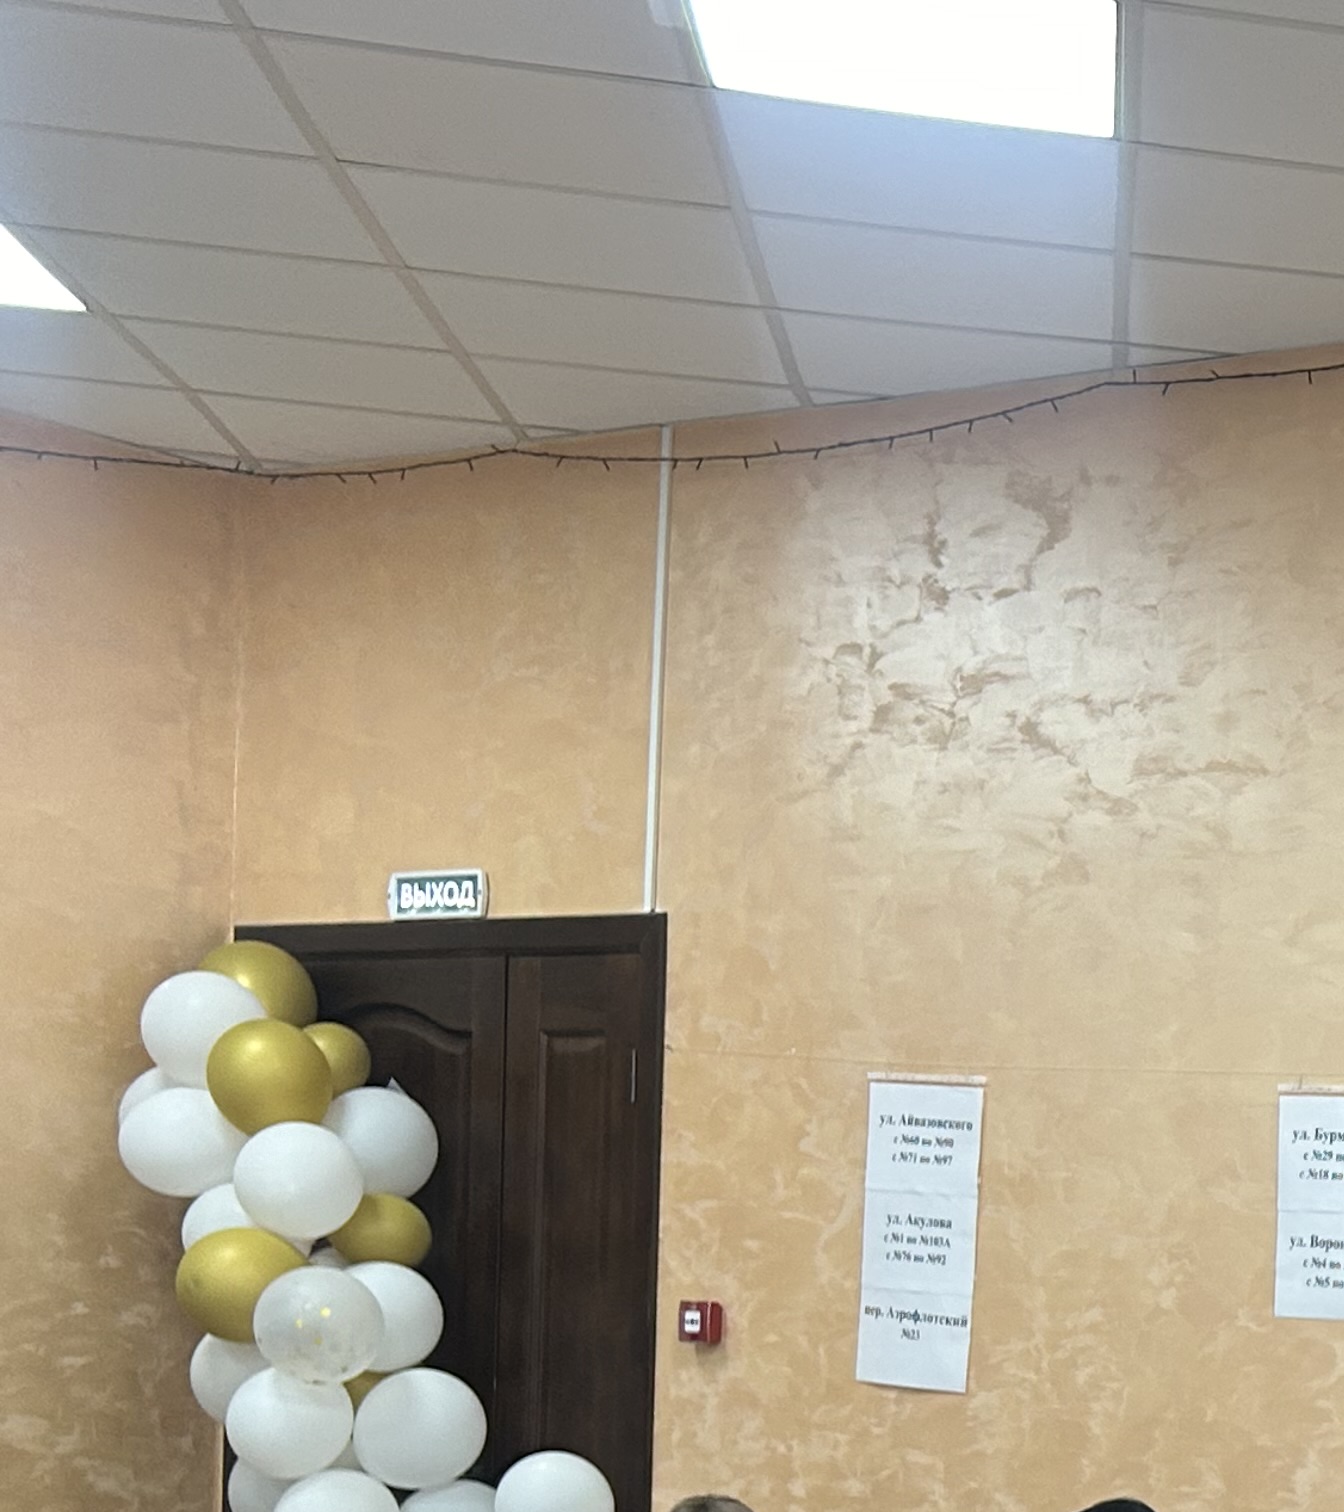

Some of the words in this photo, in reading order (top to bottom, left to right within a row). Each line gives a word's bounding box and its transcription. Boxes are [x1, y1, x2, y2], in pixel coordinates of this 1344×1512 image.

[400, 880, 475, 908] ВЫХОД
[1292, 1130, 1310, 1143] ул.
[886, 1214, 902, 1227] ул.
[905, 1213, 952, 1230] Акулова
[1290, 1236, 1306, 1250] ул.
[886, 1306, 967, 1327] Аэрофлотский
